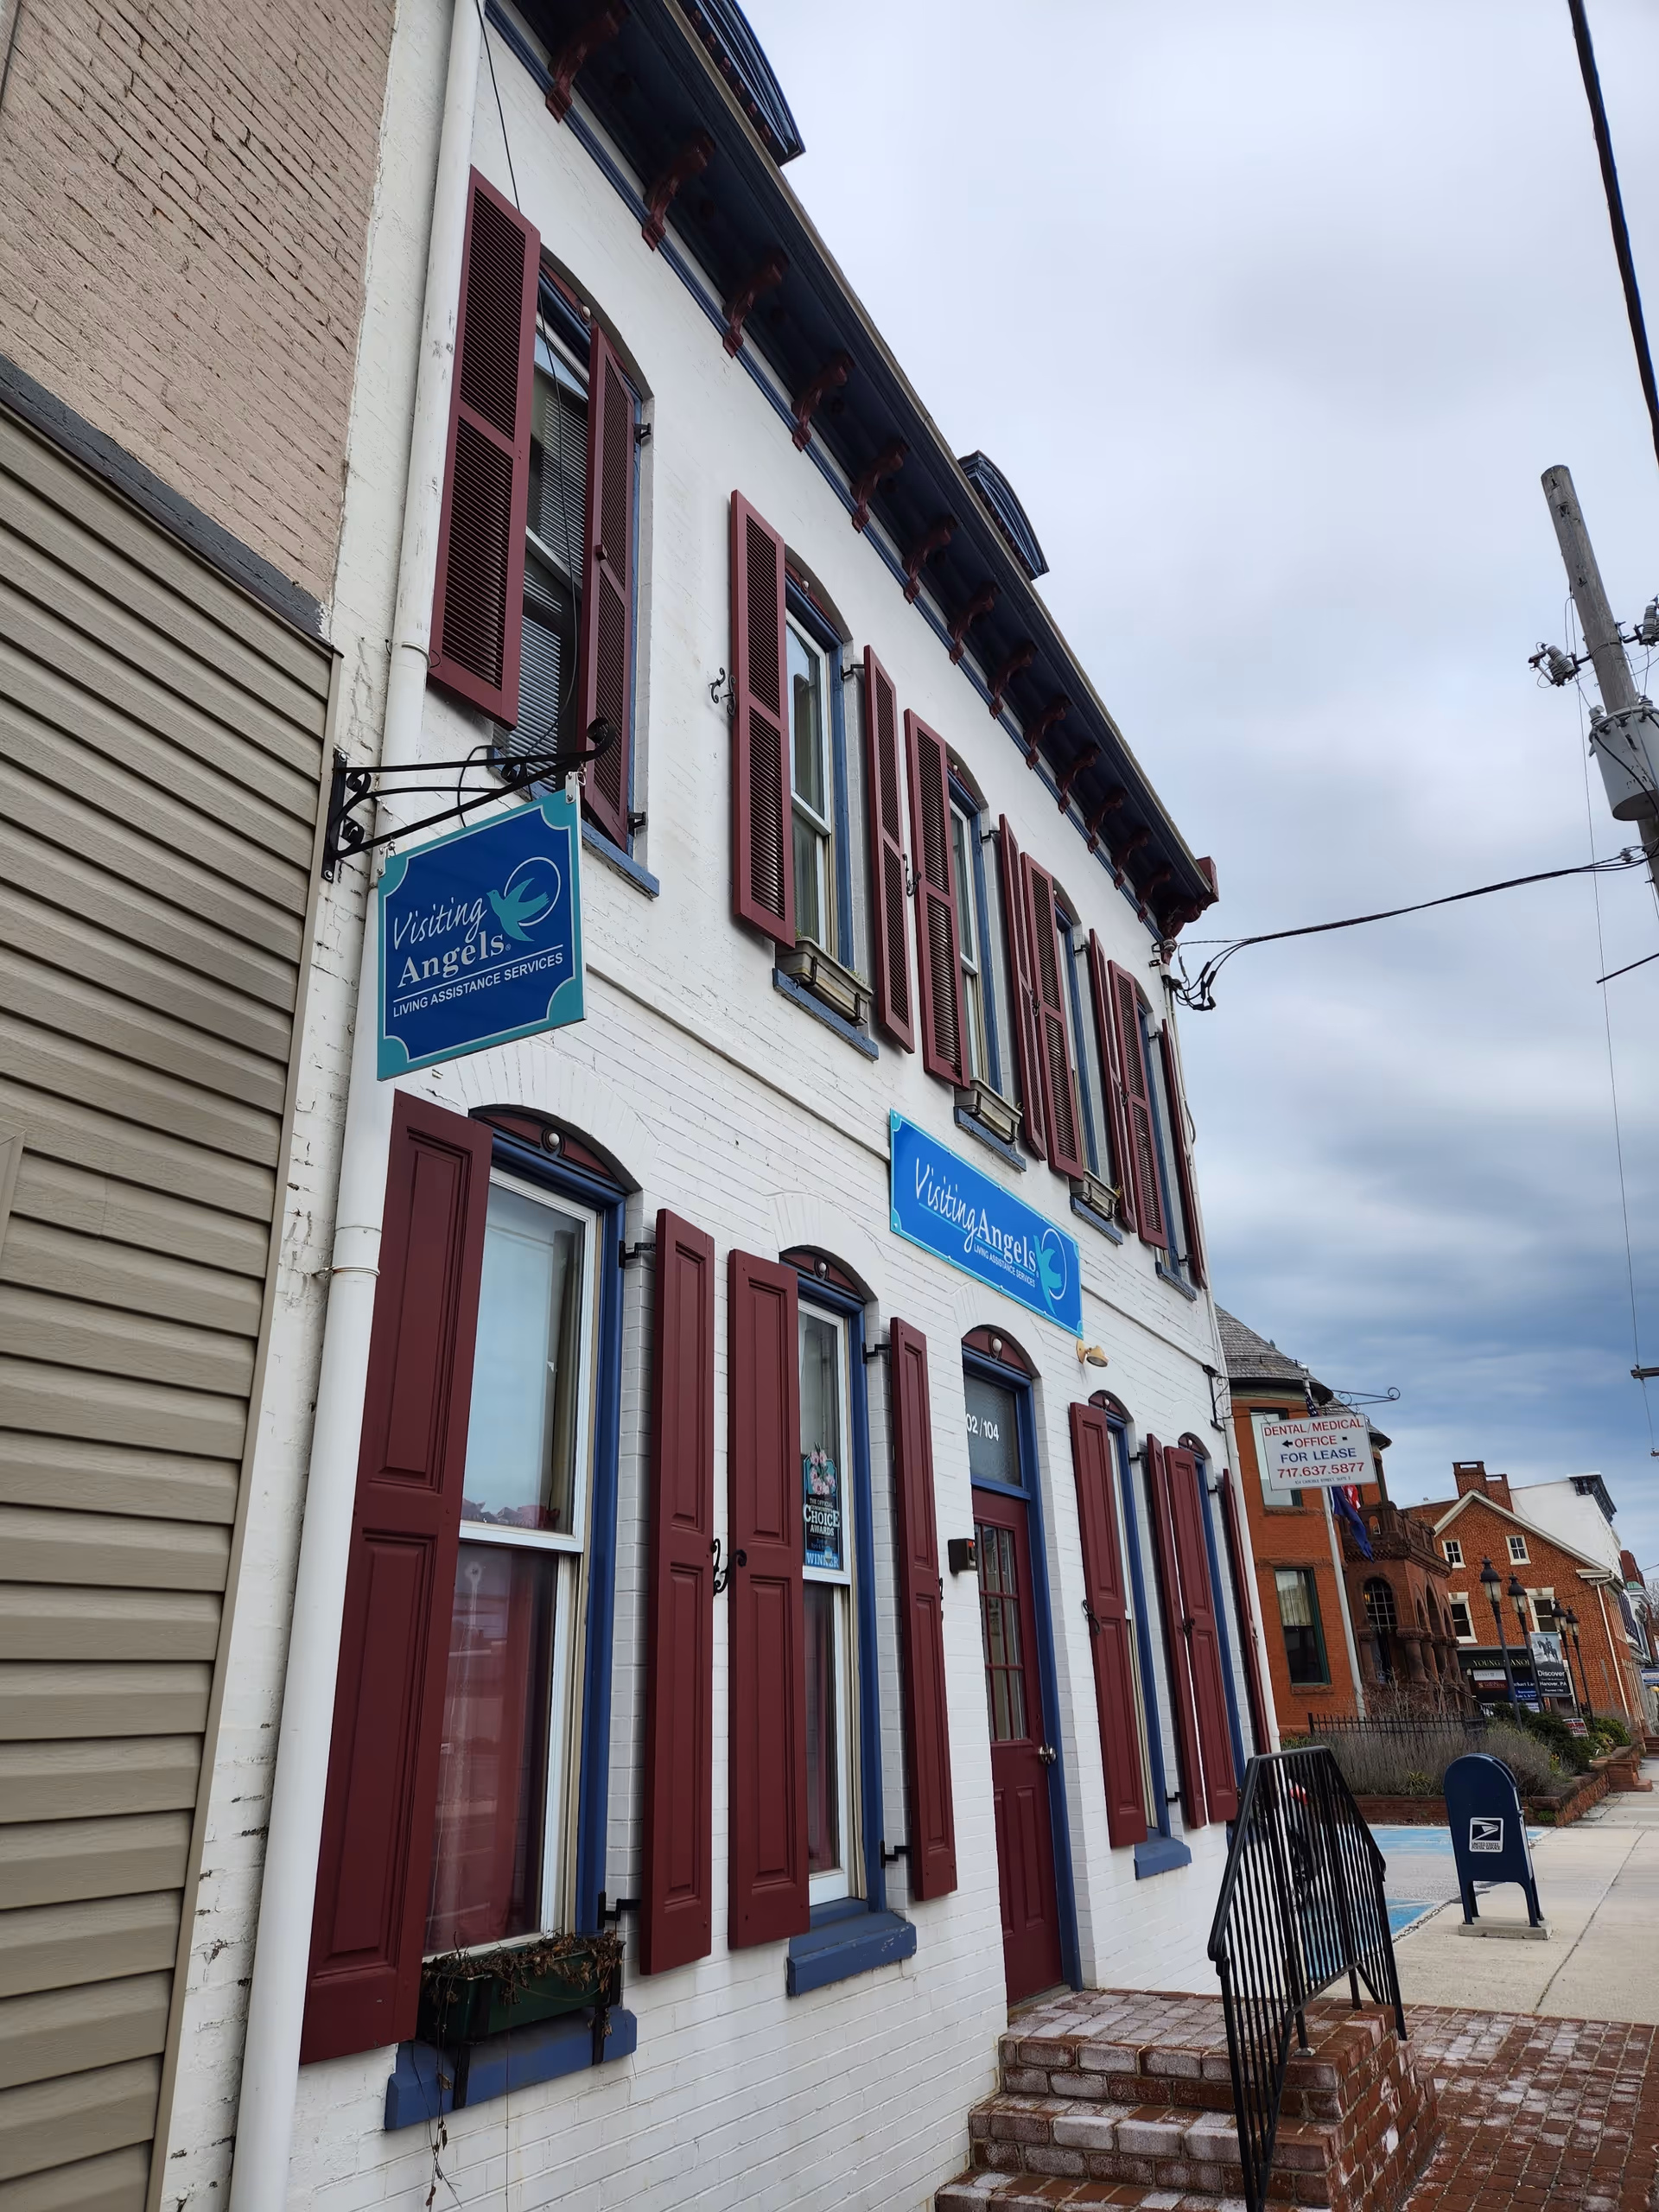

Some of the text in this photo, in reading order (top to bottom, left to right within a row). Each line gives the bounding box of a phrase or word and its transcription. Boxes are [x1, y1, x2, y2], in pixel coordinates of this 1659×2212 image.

[393, 896, 487, 950] Visiting
[397, 931, 505, 988] Angels
[393, 952, 563, 1018] LIVING ASSISTANCE SERVICES
[915, 1157, 1036, 1273] Visiting Angels
[974, 1243, 1036, 1288] LIVING ASSISTANCE SERVICES
[1264, 1418, 1364, 1436] DENTAL/MEDICAL
[1294, 1434, 1338, 1448] OFFICE
[1281, 1447, 1357, 1464] FOR LEASE
[1277, 1462, 1365, 1478] 717.637.5877
[803, 1503, 841, 1528] CHOICE
[810, 1524, 835, 1536] AWARDS
